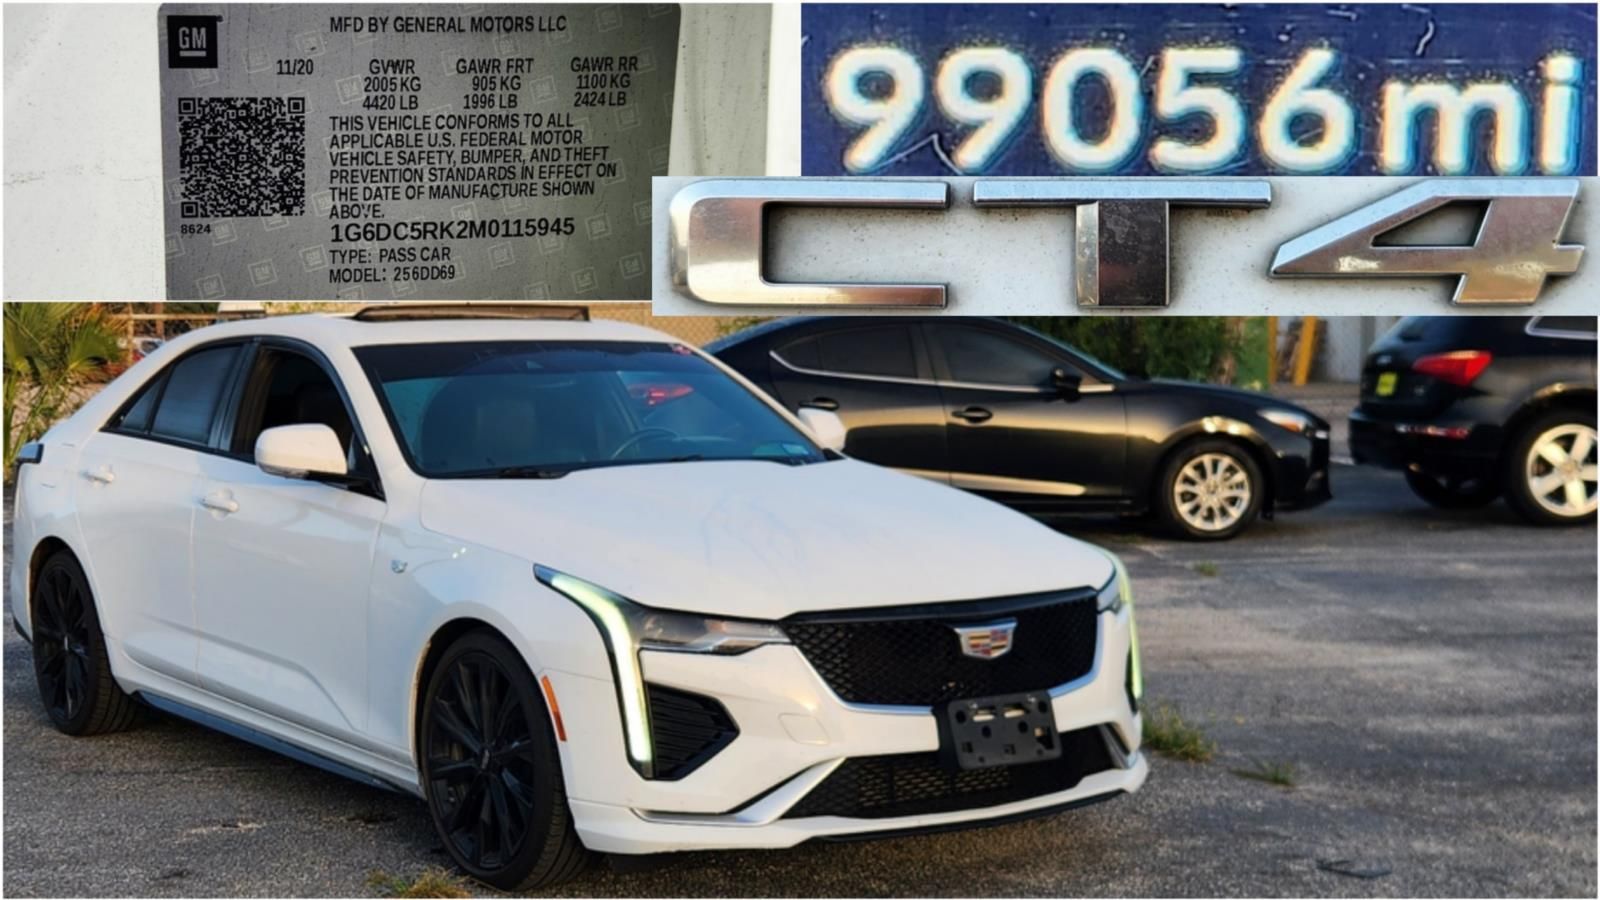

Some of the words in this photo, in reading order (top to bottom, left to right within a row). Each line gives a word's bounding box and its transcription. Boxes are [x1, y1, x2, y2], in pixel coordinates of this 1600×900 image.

[329, 15, 365, 33] MFD
[367, 15, 390, 34] BY
[392, 15, 467, 34] GENERAL
[469, 15, 535, 33] MOTORS
[538, 14, 567, 32] LLC
[178, 27, 208, 50] GM
[276, 58, 314, 77] 11/20
[368, 58, 416, 76] GVWR
[455, 57, 502, 75] GAWR
[505, 57, 535, 74] FRT
[570, 55, 615, 73] GAWR
[617, 55, 639, 72] RR
[363, 75, 398, 93] 2005
[399, 75, 422, 93] KG
[471, 74, 497, 92] 905
[499, 74, 522, 92] KG
[575, 72, 608, 90] 1100
[609, 72, 632, 89] KG
[361, 93, 396, 111] 4420
[399, 94, 419, 111] LB
[463, 92, 496, 110] 1996
[498, 93, 518, 110] LB
[573, 90, 607, 108] 2424
[607, 90, 627, 107] LB
[826, 46, 1357, 173] 99056
[1379, 55, 1583, 174] mi
[328, 114, 365, 132] THIS
[366, 114, 432, 132] VEHICLE
[434, 113, 521, 131] CONFORMS
[522, 112, 544, 129] TO
[546, 111, 575, 129] ALL
[329, 132, 424, 150] APPLICABLE
[427, 131, 456, 148] U.S.
[459, 130, 528, 148] FEDERAL
[530, 129, 583, 147] MOTOR
[329, 150, 394, 168] VEHICLE
[395, 149, 460, 170] SAFETY,
[460, 147, 529, 168] BUMPER,
[529, 147, 563, 163] AND
[565, 145, 610, 163] THEFT
[329, 167, 425, 187] PREVENTION
[427, 165, 517, 183] STANDARDS
[520, 164, 535, 181] IN
[537, 163, 593, 180] EFFECT
[595, 162, 617, 178] ON
[328, 186, 359, 203] THE
[362, 185, 401, 202] DATE
[404, 184, 425, 201] OF
[428, 180, 539, 199] MANUFACTURE
[541, 180, 596, 197] SHOWN
[328, 203, 385, 220] ABOVE.
[180, 223, 211, 235] 8624
[330, 217, 576, 242] 1G6DC5RK2M0115945
[669, 179, 1586, 308] CT4
[328, 248, 372, 265] TYPE:
[378, 246, 417, 264] PASS
[419, 245, 452, 262] CAR
[328, 267, 387, 284] MODEL:
[393, 264, 456, 282] 256DD69
